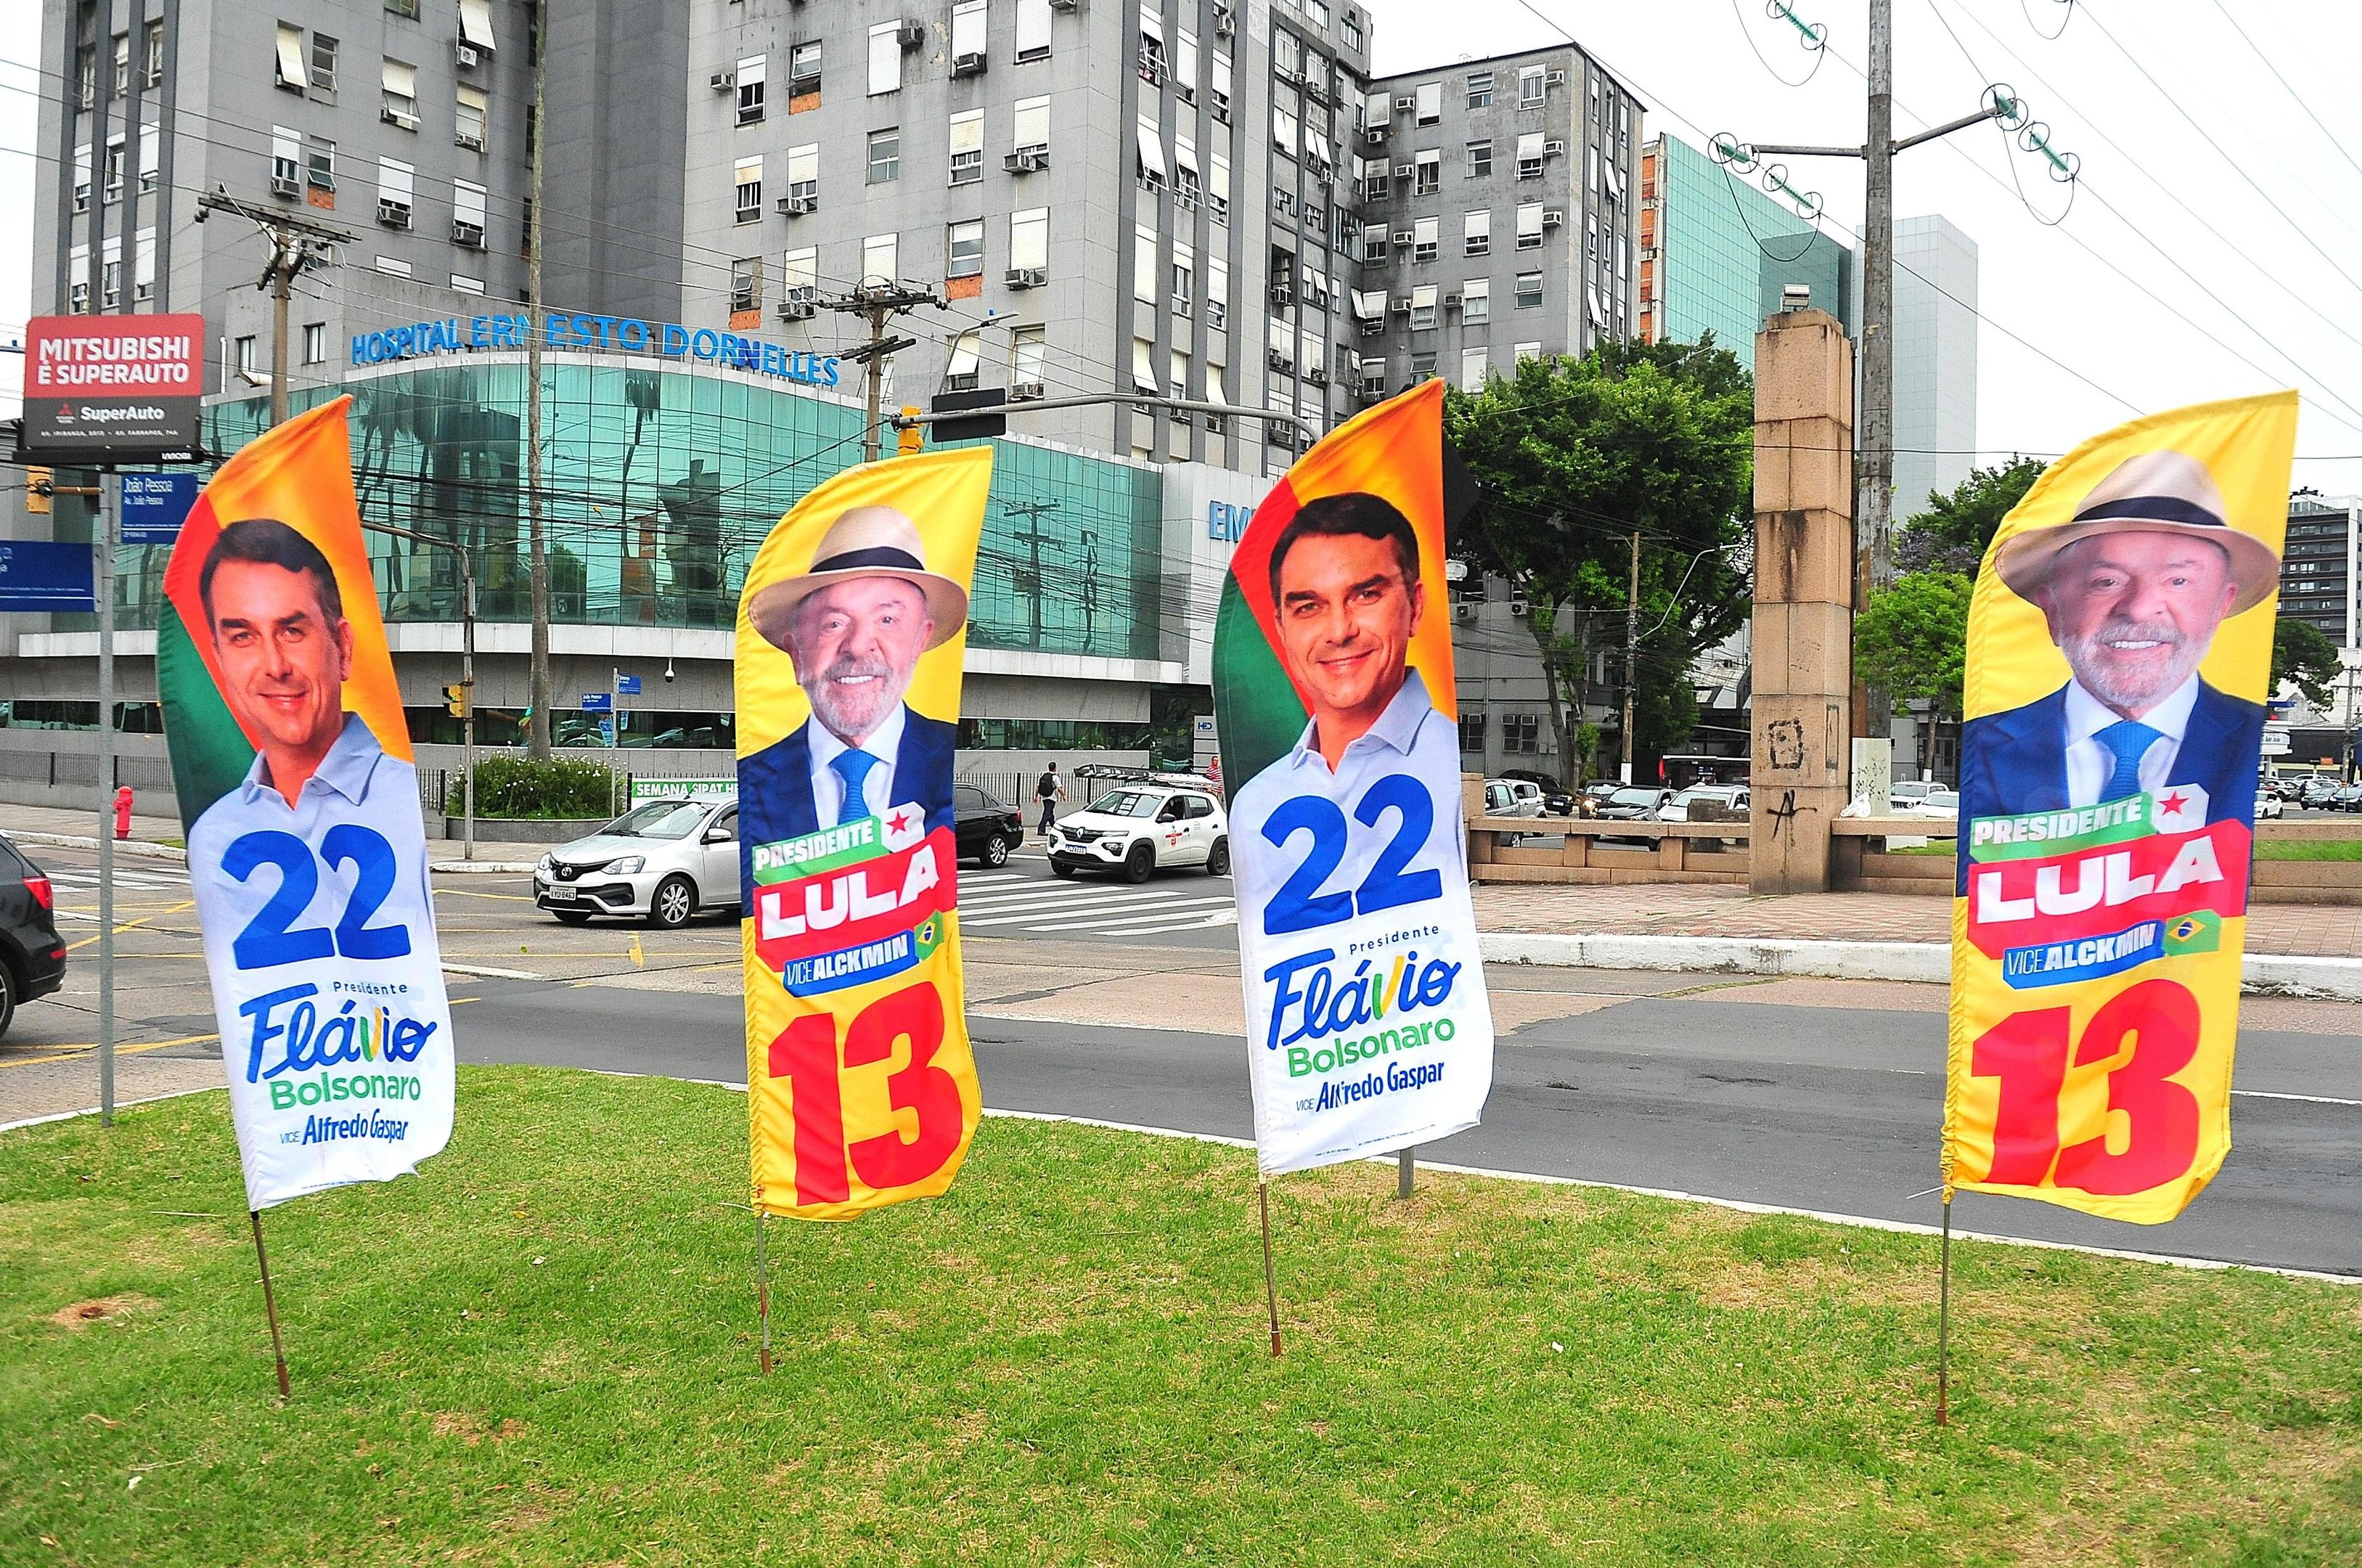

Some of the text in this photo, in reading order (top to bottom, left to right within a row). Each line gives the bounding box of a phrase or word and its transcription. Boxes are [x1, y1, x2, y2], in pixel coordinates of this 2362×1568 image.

[38, 360, 189, 385] É SUPERAUTO
[39, 336, 190, 362] MITSUBISHI
[352, 319, 465, 364] HOSPITAL
[663, 324, 838, 385] DORNELLES
[81, 406, 165, 423] SuperAuto
[124, 477, 173, 493] João Pessoa
[637, 783, 688, 796] SEMANA
[691, 783, 724, 794] SIPAT
[754, 820, 873, 871] PRESIDENTE
[1974, 796, 2143, 846] PRESIDENTE
[1261, 774, 1442, 935] 22
[1977, 836, 2224, 923] LULA
[220, 824, 412, 970] 22
[761, 844, 940, 940] LULA
[787, 934, 908, 986] VICE ALCKMIN
[1349, 926, 1439, 955] Presidente
[2008, 923, 2157, 976] VICE ALCKMIN
[333, 981, 408, 995] Presidente
[1264, 948, 1461, 1050] Flávio
[239, 982, 438, 1084] Flávio
[1287, 1018, 1455, 1077] Bolsonaro
[269, 1071, 422, 1110] Bolsonaro
[768, 981, 963, 1206] 13
[1296, 1098, 1315, 1111] VICE
[1387, 1061, 1444, 1092] Gaspar
[1971, 979, 2202, 1196] 13
[279, 1108, 409, 1146] VICE Alfredo Gaspar
